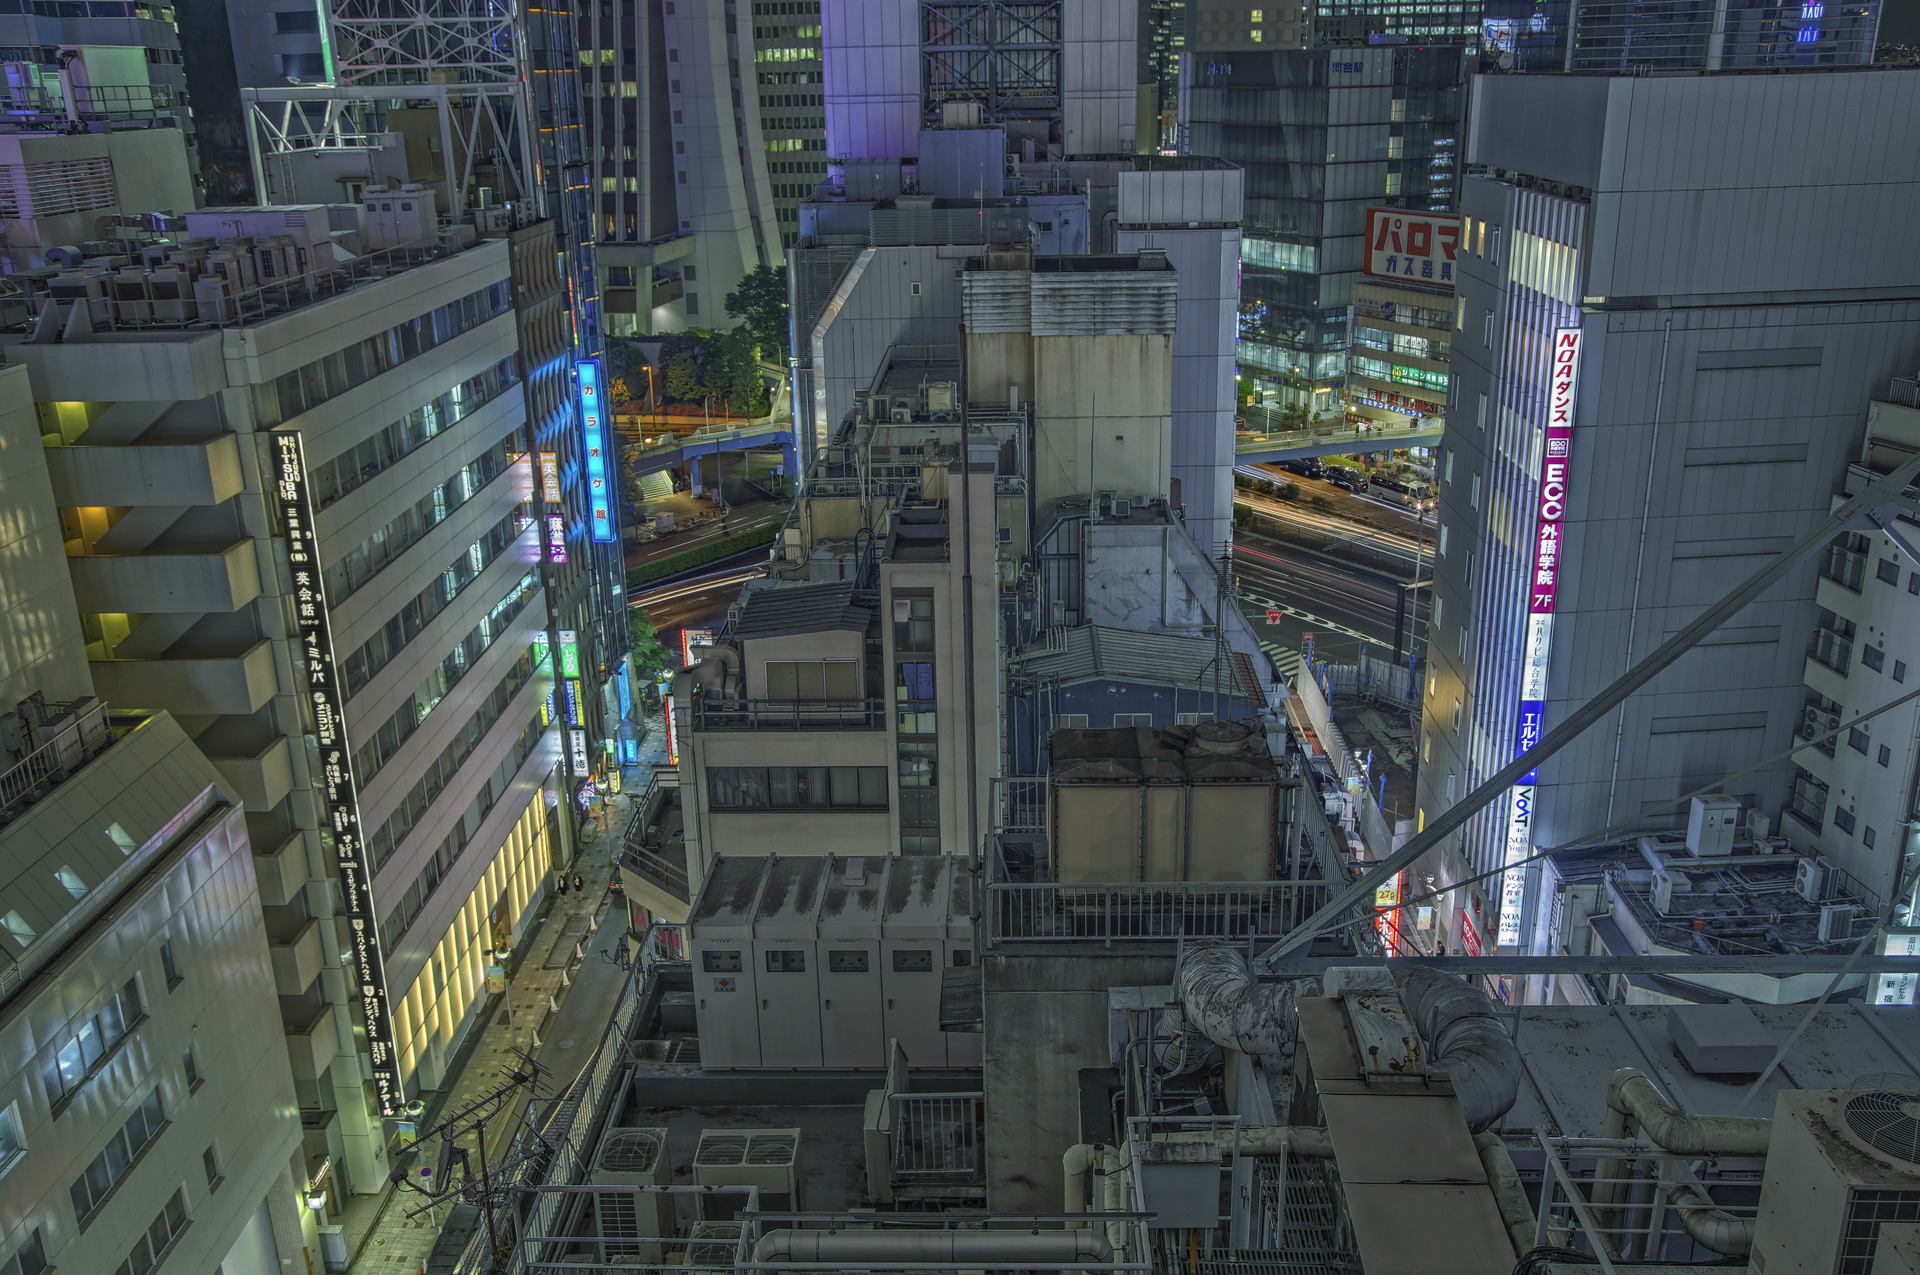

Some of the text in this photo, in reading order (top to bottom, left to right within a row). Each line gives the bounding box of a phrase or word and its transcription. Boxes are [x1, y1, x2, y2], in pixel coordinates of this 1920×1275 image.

[1375, 217, 1459, 260] パロマ
[1386, 255, 1452, 281] ガス器具
[278, 436, 297, 500] MITSUBA
[289, 436, 300, 482] SHINJUKU
[583, 385, 607, 520] カラオケ館
[542, 462, 559, 501] 英会話
[306, 531, 312, 539] 9
[549, 517, 565, 545] 麻雀
[296, 571, 314, 617] 英会話
[316, 593, 322, 601] 9
[1534, 594, 1552, 607] 7F
[565, 650, 575, 672] レイク
[1529, 627, 1544, 698] ハクビ総合学院
[343, 773, 349, 781] 7
[1509, 845, 1527, 853] Yoga
[1884, 981, 1895, 1003] 新宿
[364, 997, 377, 1037] ダンディハウス
[379, 1079, 394, 1116] ルノアール
